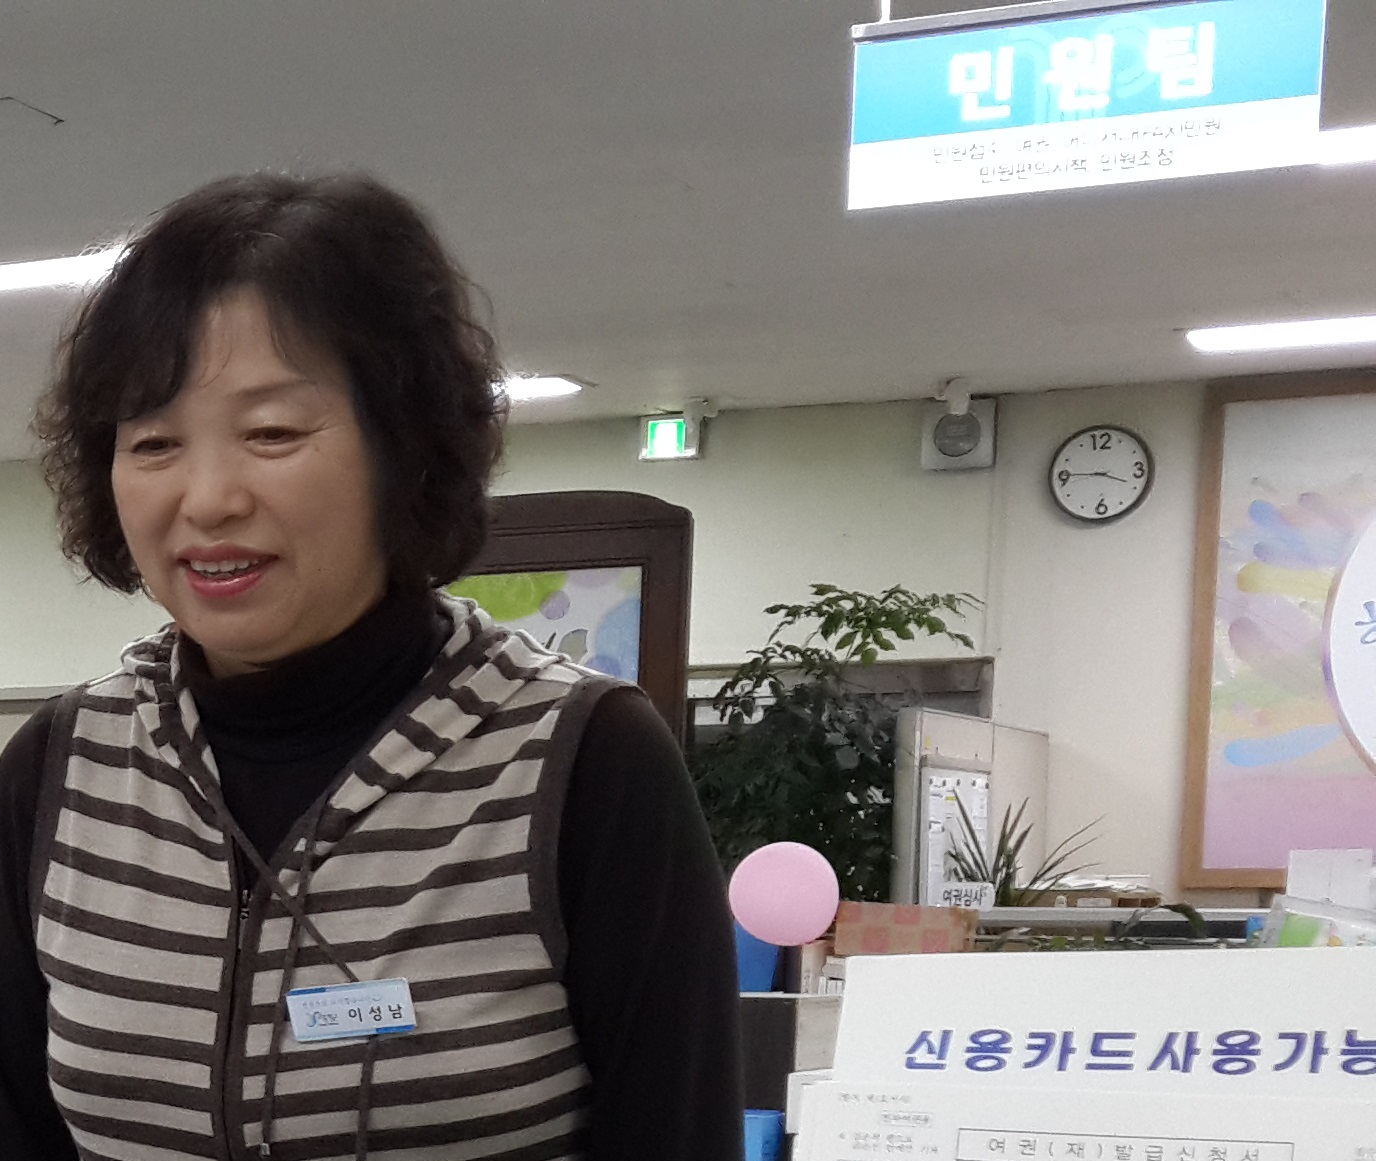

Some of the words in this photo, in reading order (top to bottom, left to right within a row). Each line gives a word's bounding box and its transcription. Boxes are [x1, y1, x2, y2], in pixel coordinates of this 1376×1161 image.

[948, 21, 1216, 121] 민원팀
[1090, 433, 1112, 451] 12
[1058, 470, 1071, 487] 9
[1133, 462, 1145, 478] 3
[1095, 498, 1108, 516] 6
[348, 1003, 403, 1023] 이성남
[904, 1027, 1376, 1077] 신용카드사용가능
